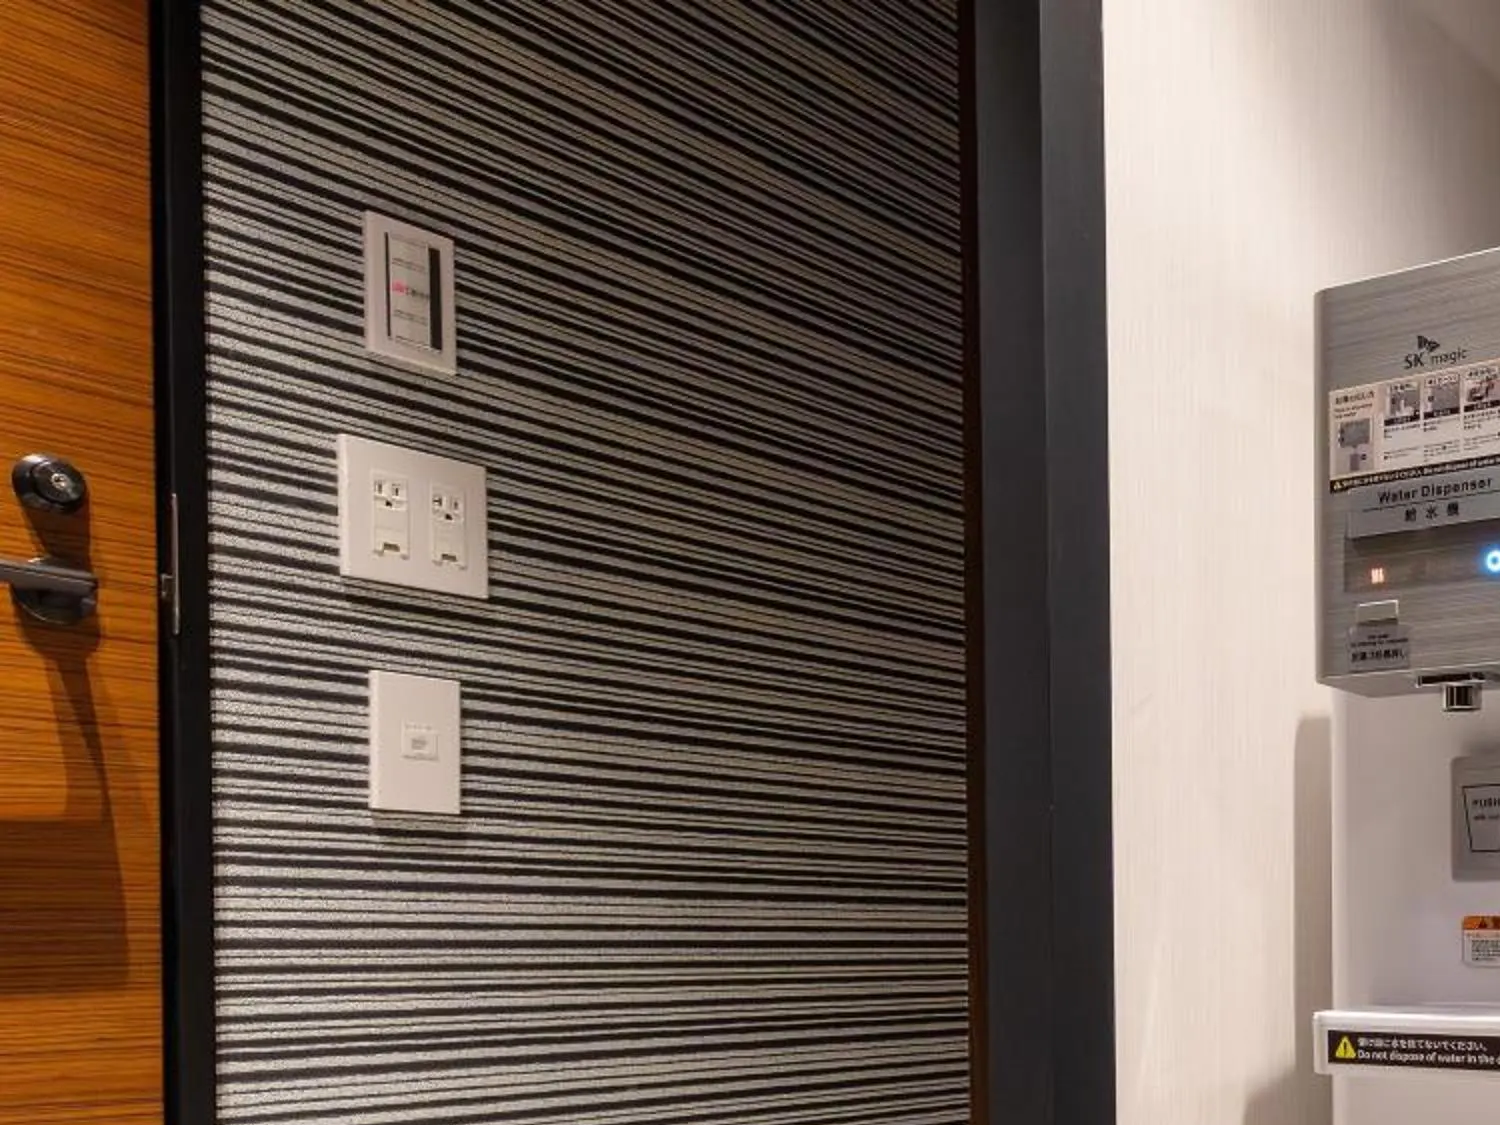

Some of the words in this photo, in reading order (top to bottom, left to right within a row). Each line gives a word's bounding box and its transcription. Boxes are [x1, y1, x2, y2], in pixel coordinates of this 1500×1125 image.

[1404, 352, 1425, 369] SK
[1431, 347, 1467, 365] magic
[1378, 488, 1417, 503] Water
[1421, 478, 1493, 498] Dispenser
